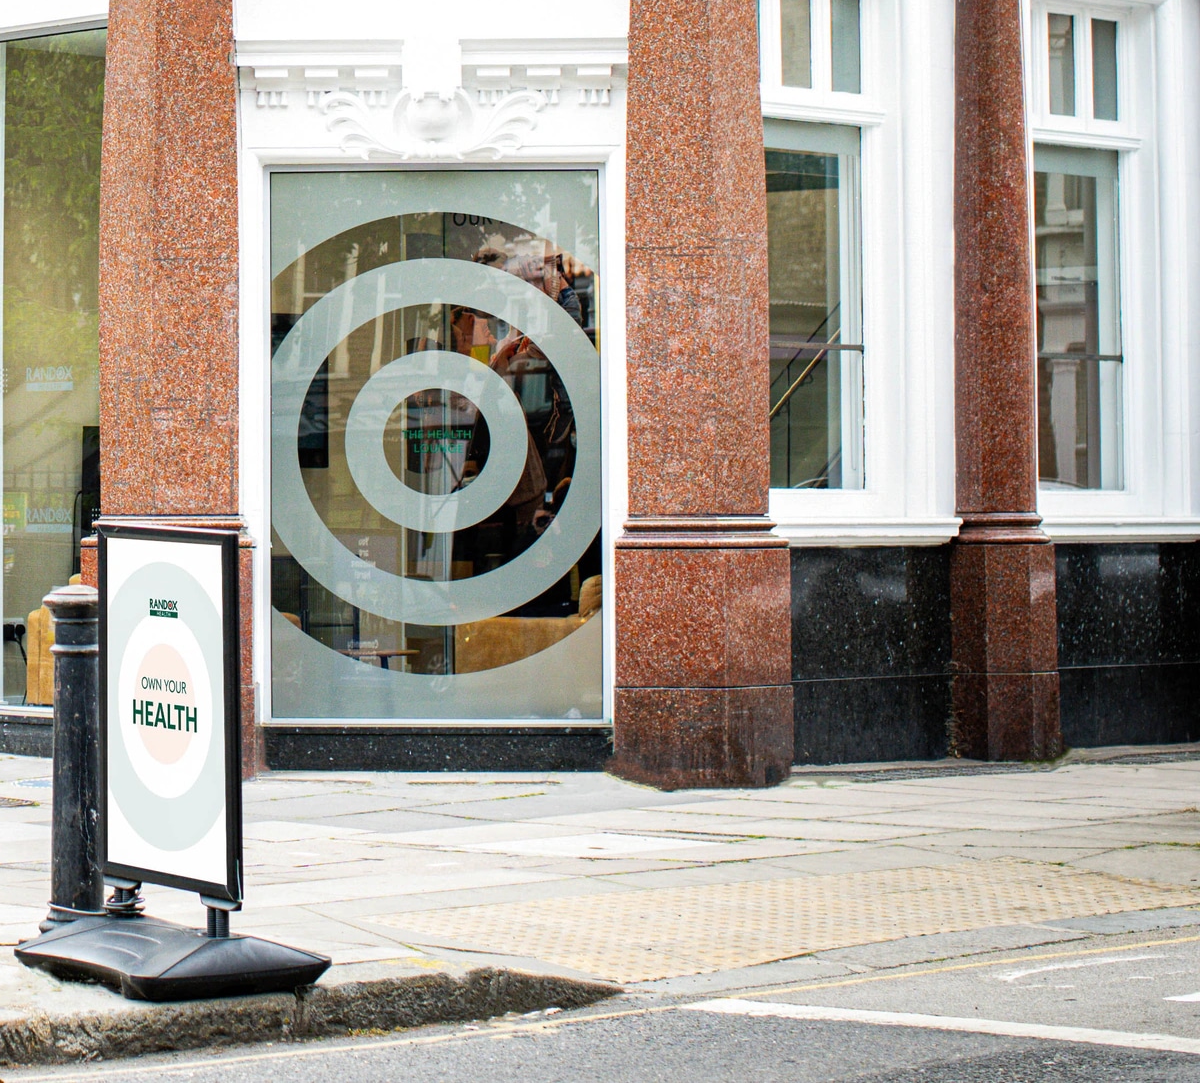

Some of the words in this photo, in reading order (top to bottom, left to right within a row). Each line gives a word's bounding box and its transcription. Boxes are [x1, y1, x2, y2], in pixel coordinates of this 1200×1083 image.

[26, 365, 73, 381] RANDOX
[402, 429, 424, 439] THE
[427, 429, 472, 439] HEALTH
[413, 443, 464, 454] LOUNGE
[149, 598, 178, 611] RANDOX
[141, 676, 162, 691] OWN
[164, 679, 187, 694] YOUR
[133, 699, 197, 733] HEALTH
